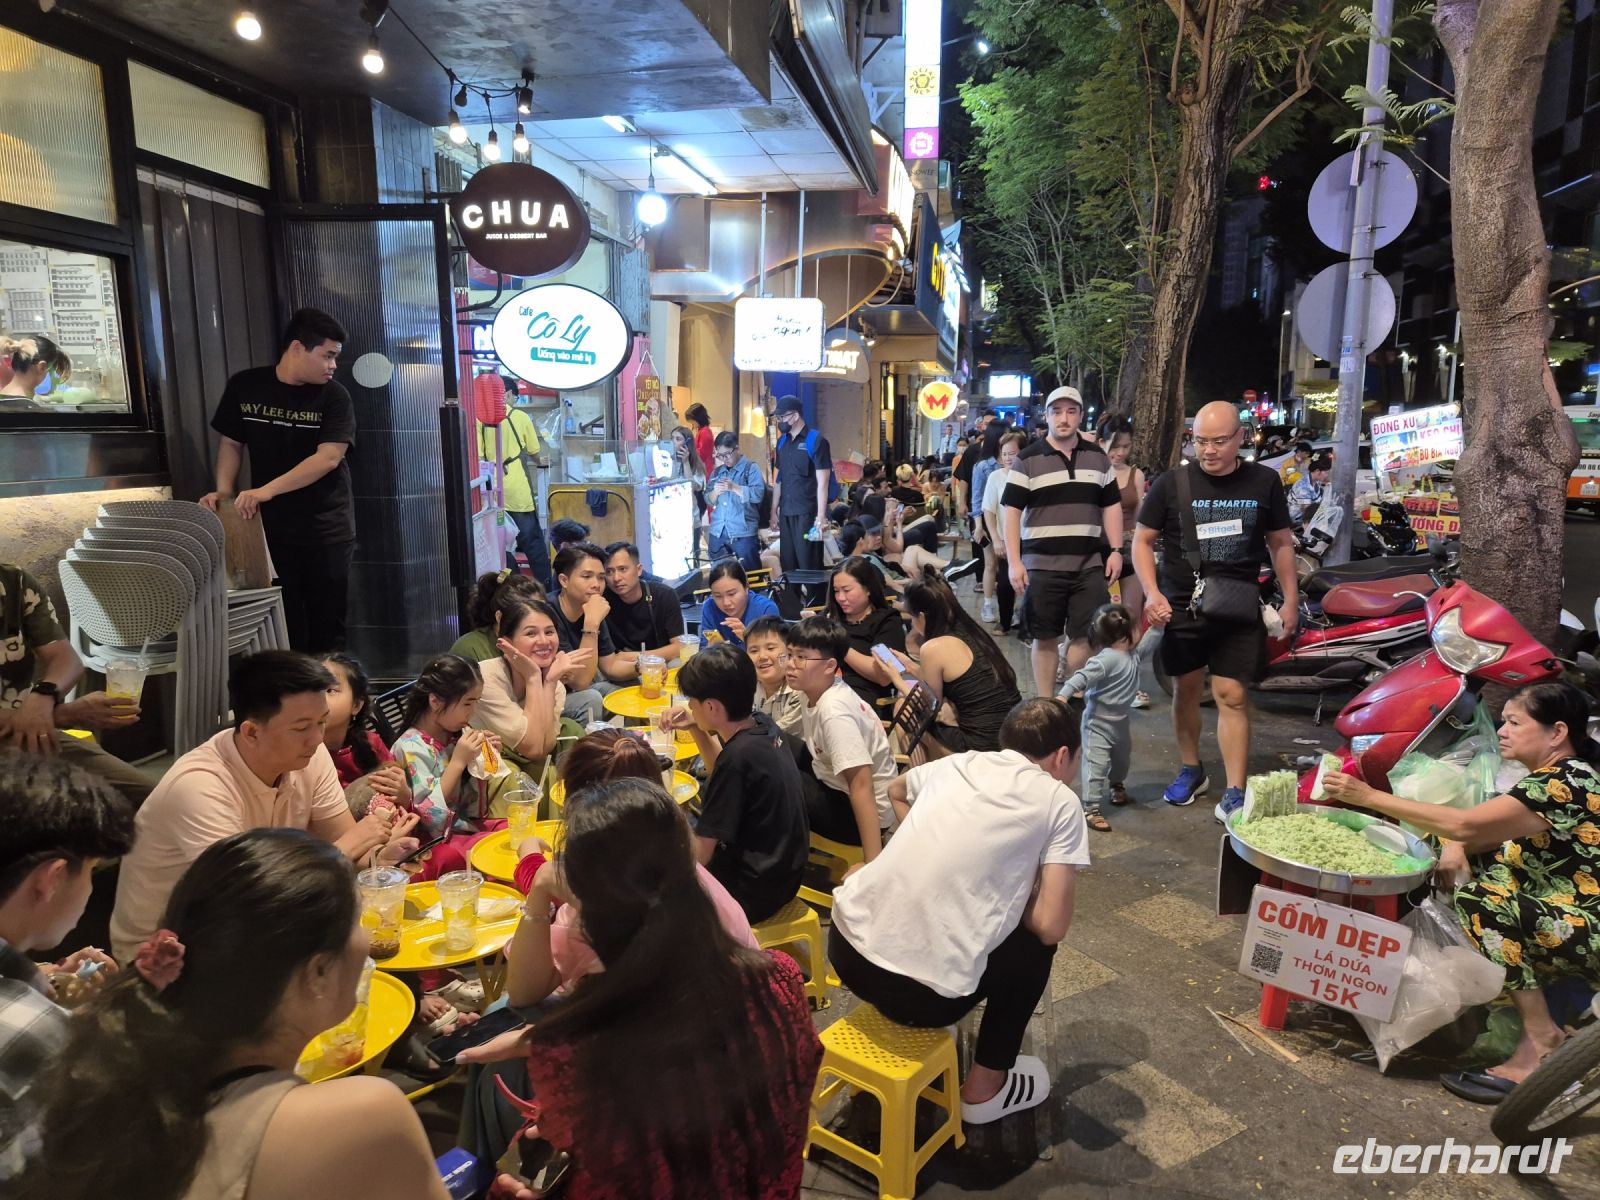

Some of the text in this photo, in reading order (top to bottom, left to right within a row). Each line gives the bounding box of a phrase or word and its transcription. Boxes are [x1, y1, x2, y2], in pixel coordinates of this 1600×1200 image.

[462, 200, 569, 229] CHUA
[560, 314, 591, 350] Ly
[262, 406, 285, 417] LEE
[1212, 499, 1258, 508] SMARTER
[1208, 524, 1237, 535] Bitget
[1257, 900, 1328, 940] CỐM
[1336, 923, 1401, 959] DẸP
[1314, 949, 1334, 964] LÁ
[1293, 957, 1337, 980] THƠM
[1341, 975, 1388, 996] NGON
[1310, 978, 1361, 1010] 15K
